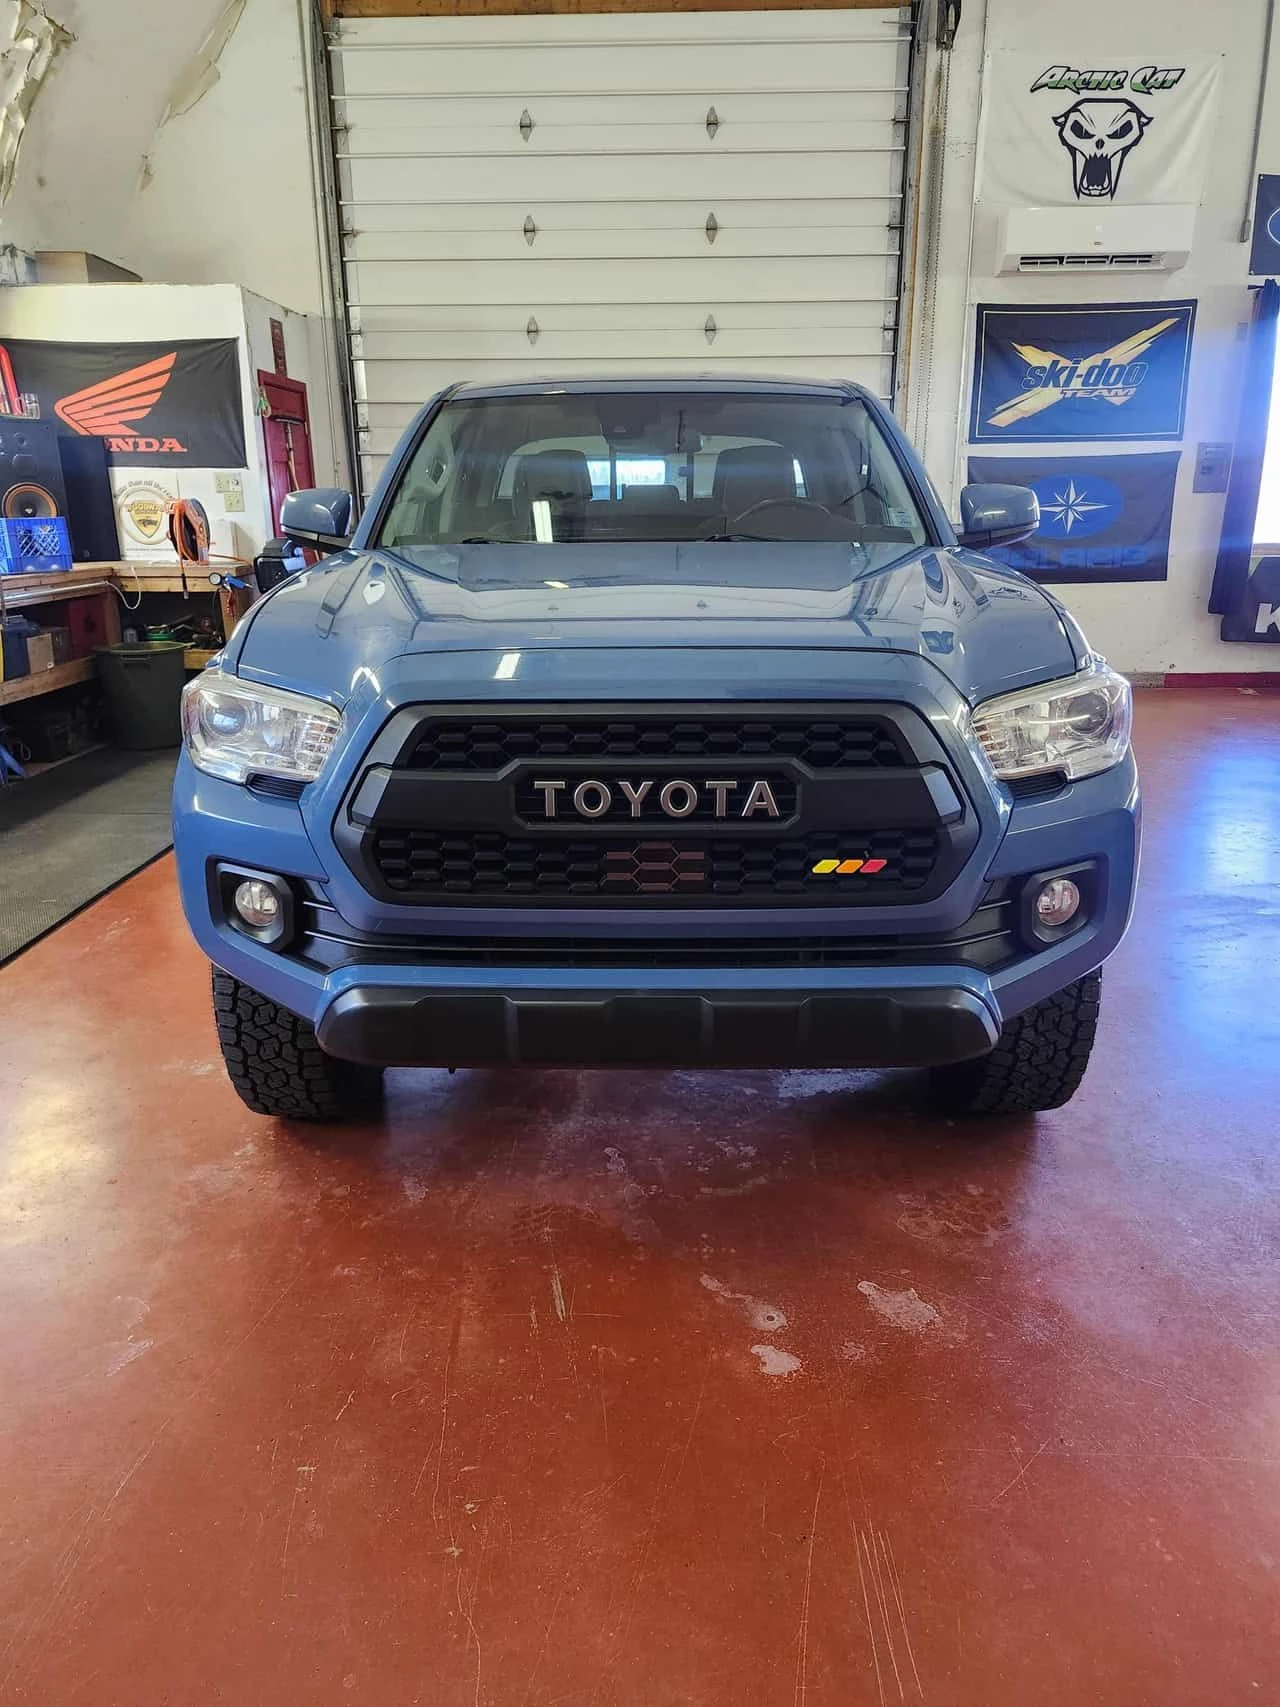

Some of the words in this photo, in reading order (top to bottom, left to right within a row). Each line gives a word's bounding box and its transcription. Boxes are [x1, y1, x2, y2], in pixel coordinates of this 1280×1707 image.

[1021, 357, 1150, 390] ski-doo
[104, 437, 188, 453] NDA
[534, 780, 780, 818] TOYOTA
